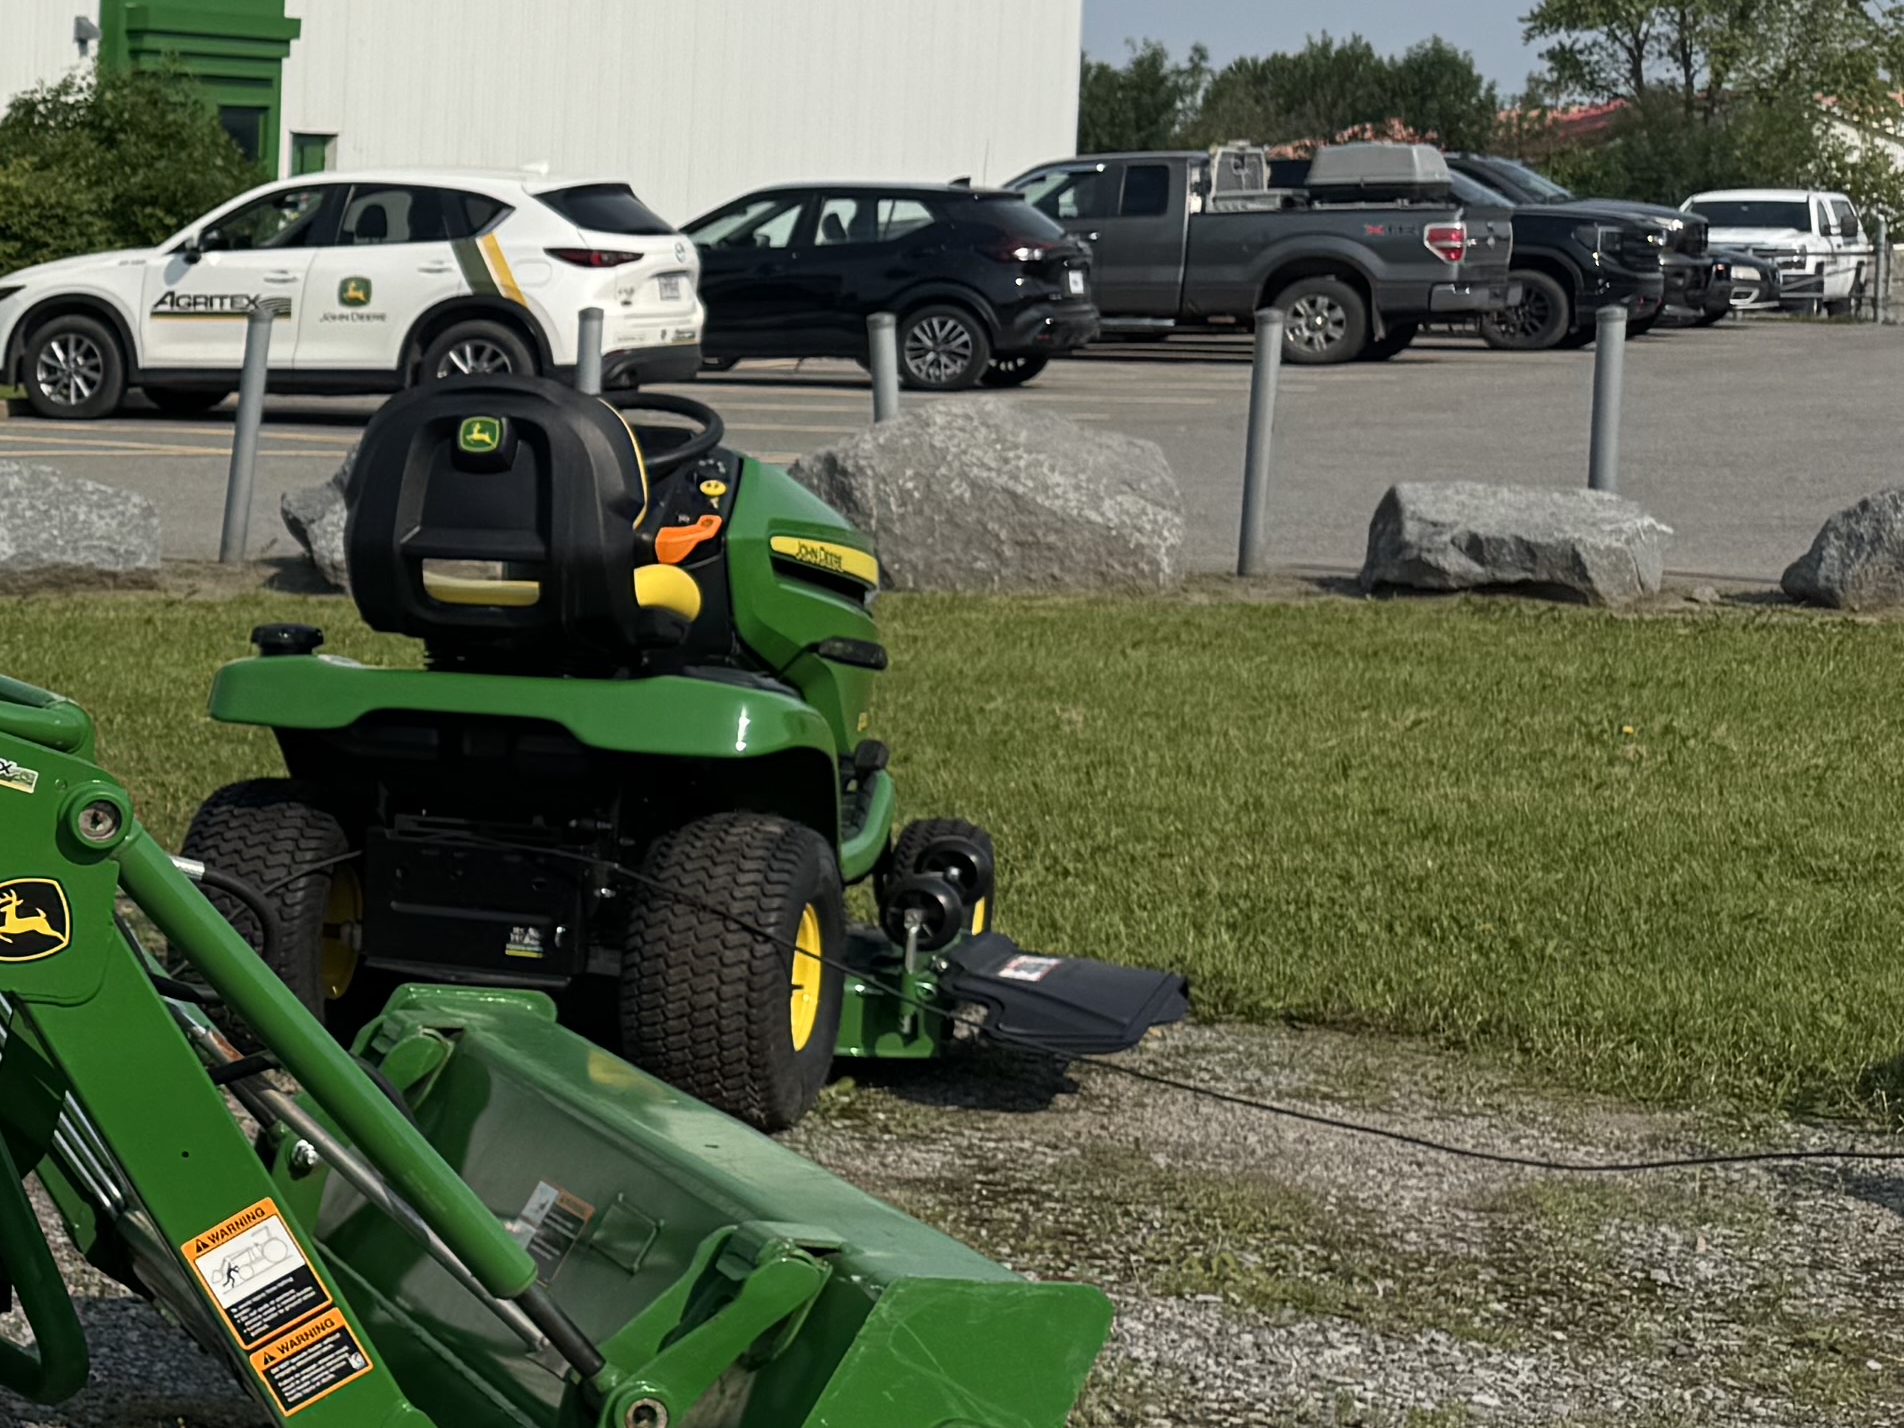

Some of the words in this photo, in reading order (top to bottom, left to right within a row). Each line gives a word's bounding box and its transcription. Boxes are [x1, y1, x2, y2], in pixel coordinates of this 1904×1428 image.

[152, 290, 263, 310] AGRITEX
[207, 1206, 266, 1245] WARNING
[276, 1317, 336, 1355] WARNING
